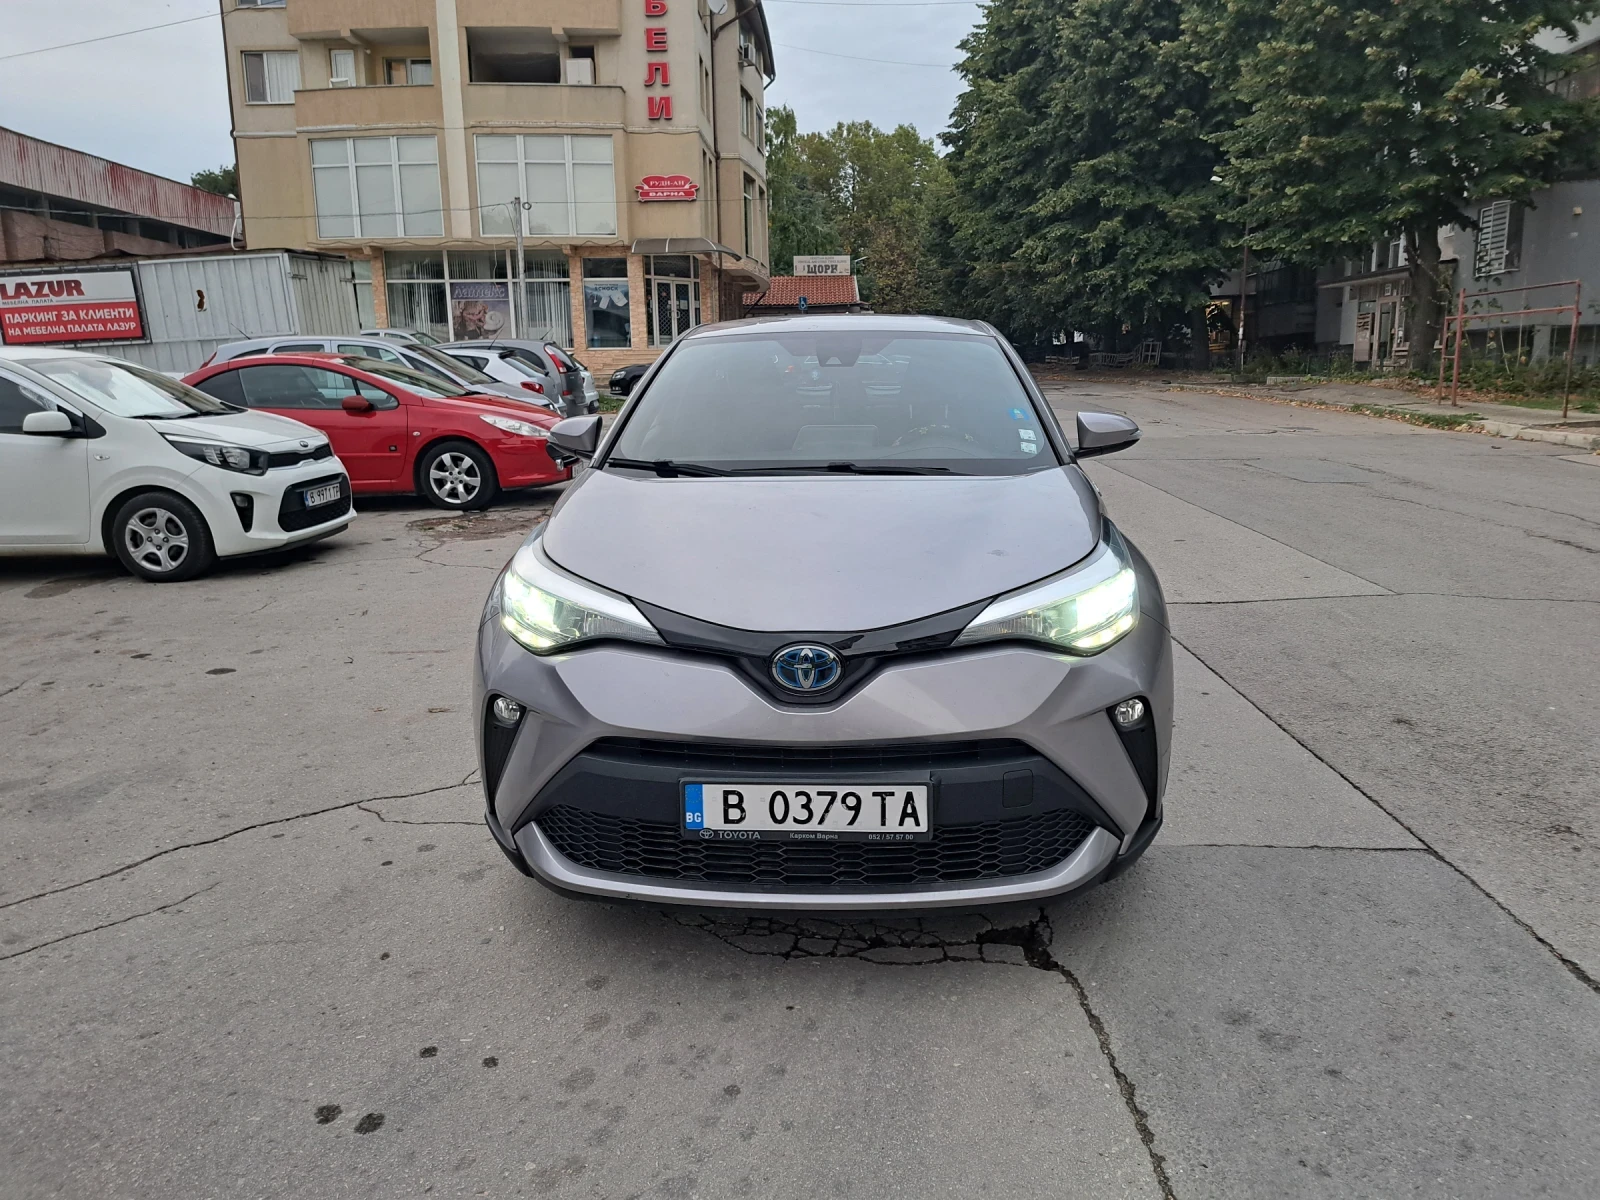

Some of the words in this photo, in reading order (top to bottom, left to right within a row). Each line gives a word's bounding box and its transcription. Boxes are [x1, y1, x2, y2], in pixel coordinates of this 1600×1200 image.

[0, 280, 85, 300] LAZUR
[5, 311, 58, 324] ПАРКИНГ
[61, 310, 77, 321] ЗА
[80, 308, 134, 320] КЛИЕНТИ
[8, 327, 21, 336] НА
[23, 325, 66, 336] МЕБЕЛНА
[68, 323, 104, 333] ПАЛАТА
[106, 321, 136, 332] ЛАЗУР
[686, 812, 702, 823] BG
[717, 830, 761, 840] TOYOTA
[816, 832, 838, 840] Варна
